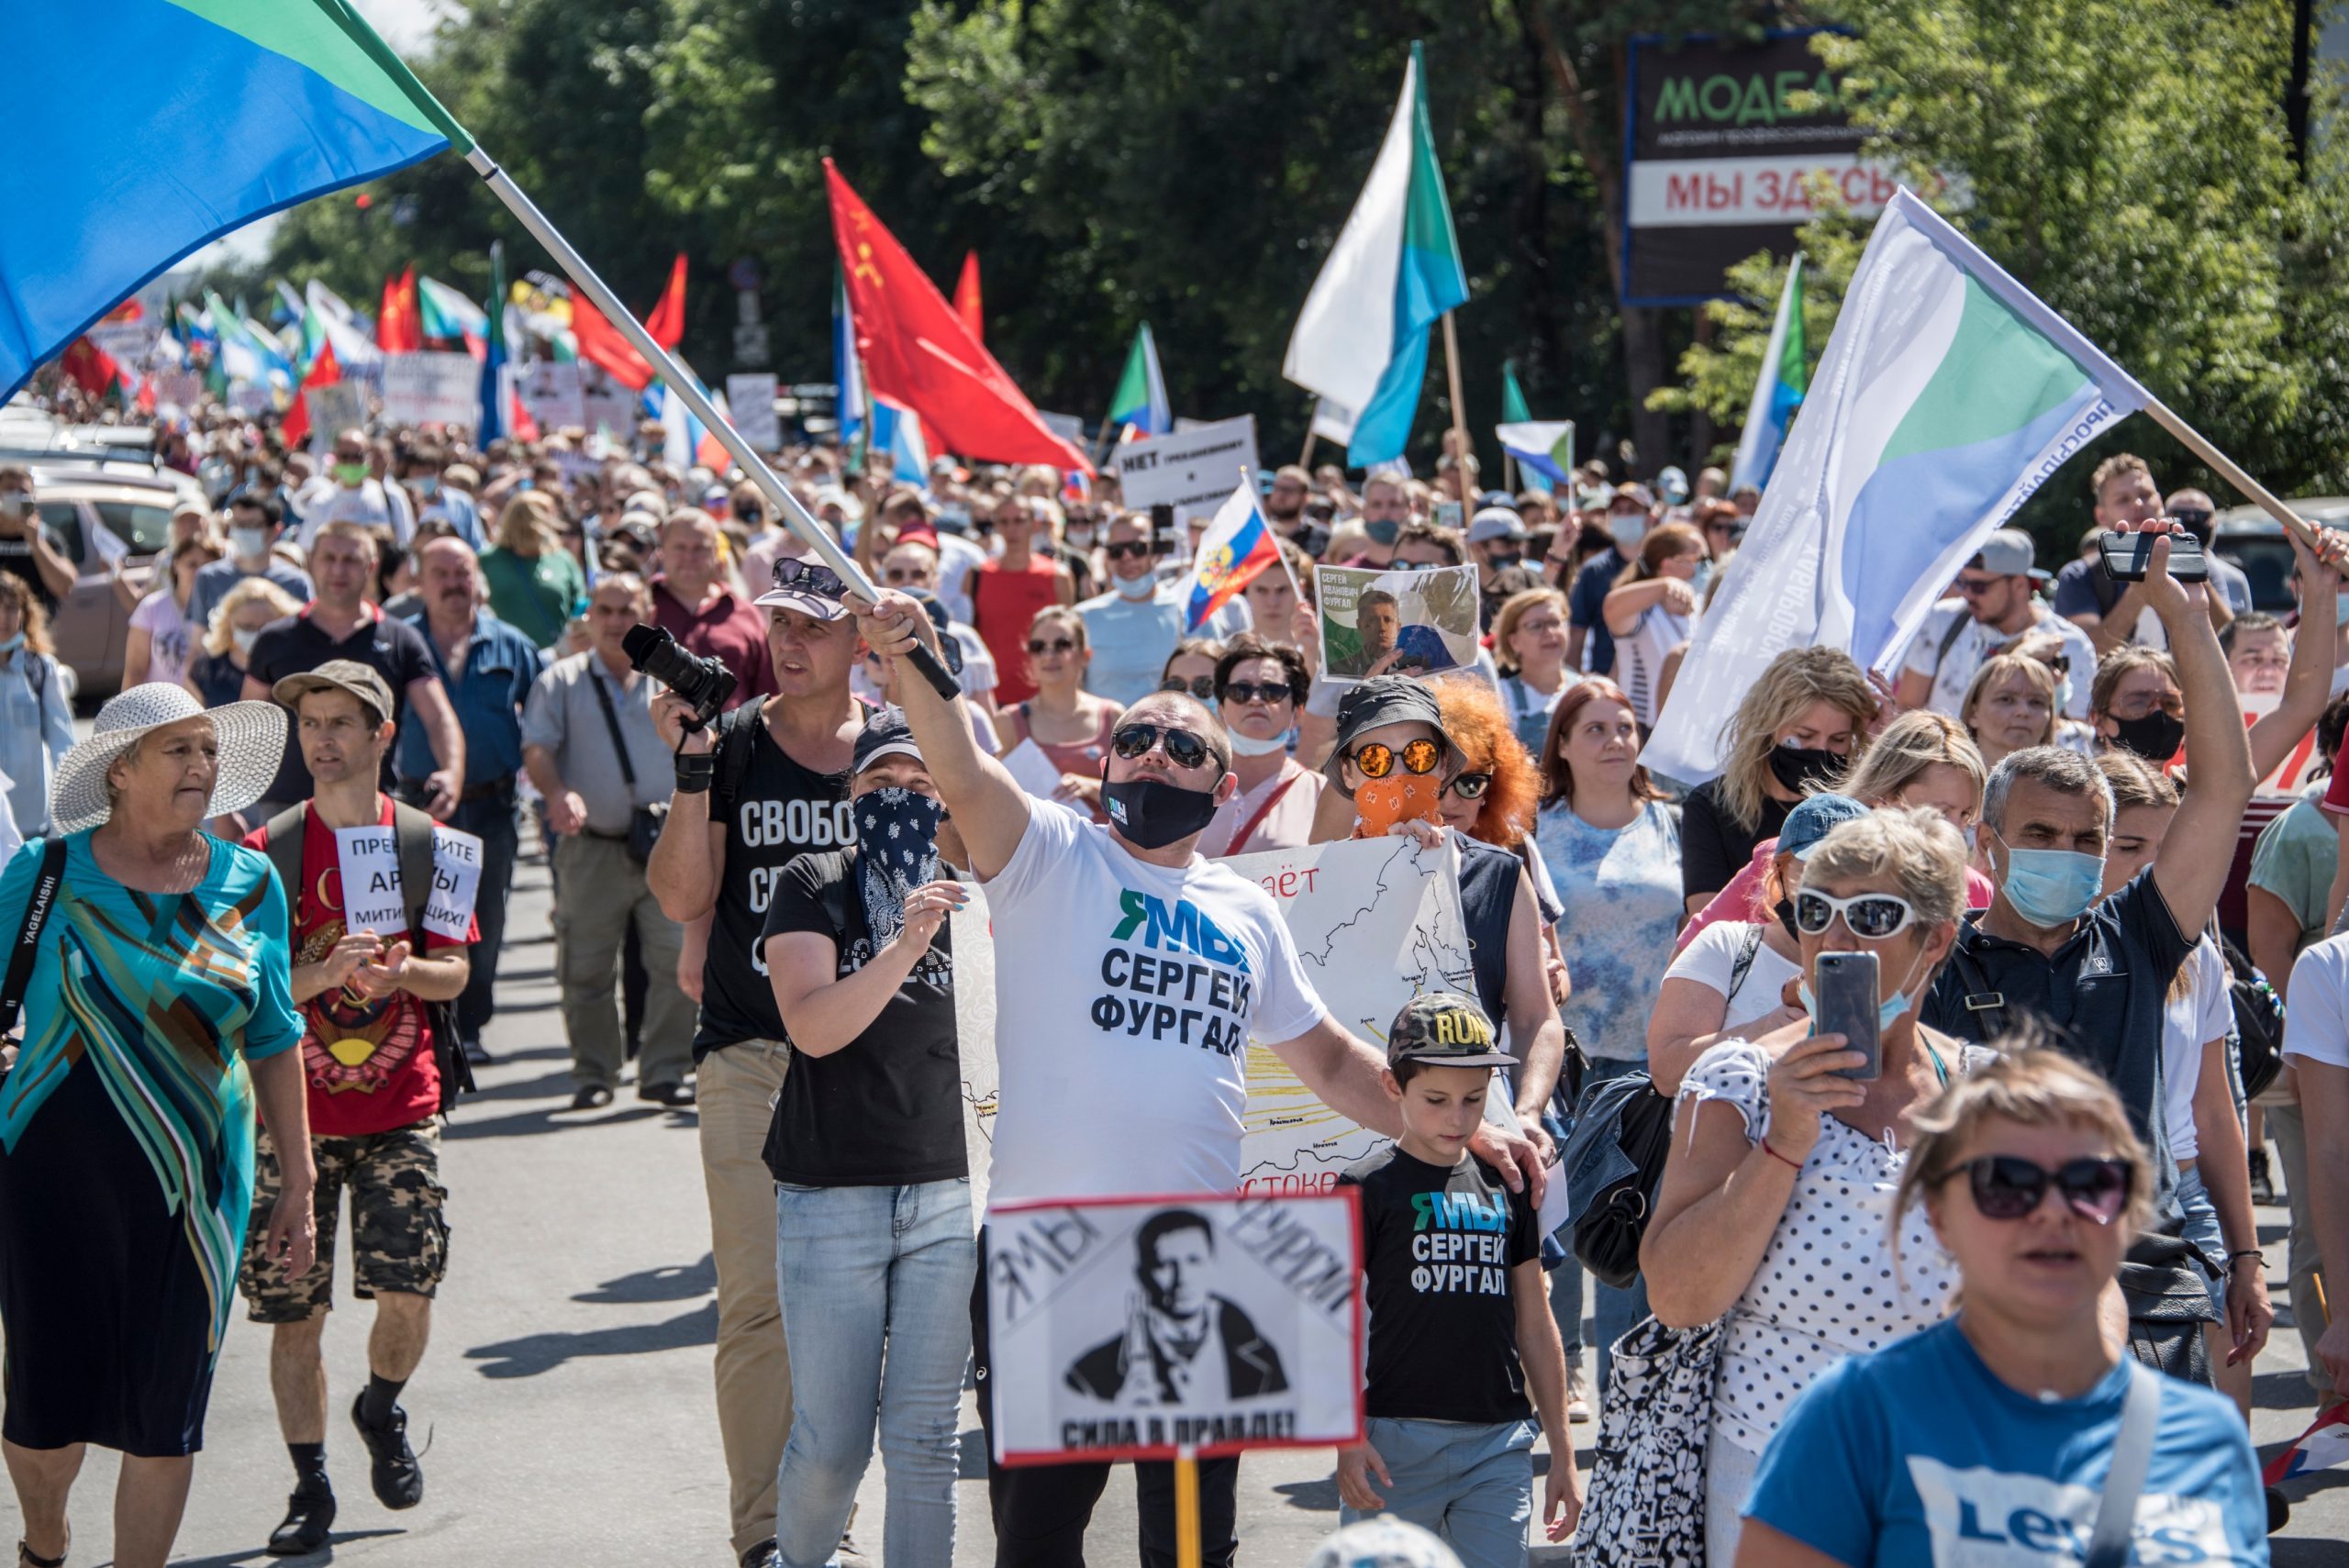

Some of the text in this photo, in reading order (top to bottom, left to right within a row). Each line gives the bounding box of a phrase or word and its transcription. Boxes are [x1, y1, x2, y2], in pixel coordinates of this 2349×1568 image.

[1665, 170, 1742, 210] МЫ
[1122, 450, 1159, 473] НЕТ
[1321, 573, 1347, 584] СЕРГЕЙ
[1322, 584, 1359, 596] ИВАНОВИЧ
[1323, 597, 1352, 609] ФУРГАЛ
[740, 799, 857, 848] СВОБО
[23, 875, 56, 946] YAGELAISHI
[1101, 948, 1252, 1019] СЕРГЕЙ
[1090, 994, 1242, 1062] ФУРГАЛ
[1435, 1009, 1489, 1046] RUN
[1410, 1192, 1508, 1233] ЯМЫ
[1411, 1233, 1506, 1265] СЕРГЕЙ
[1410, 1265, 1506, 1296] ФУРГАЛ
[1062, 1410, 1295, 1449] СИЛА В ПРАВДЕ!
